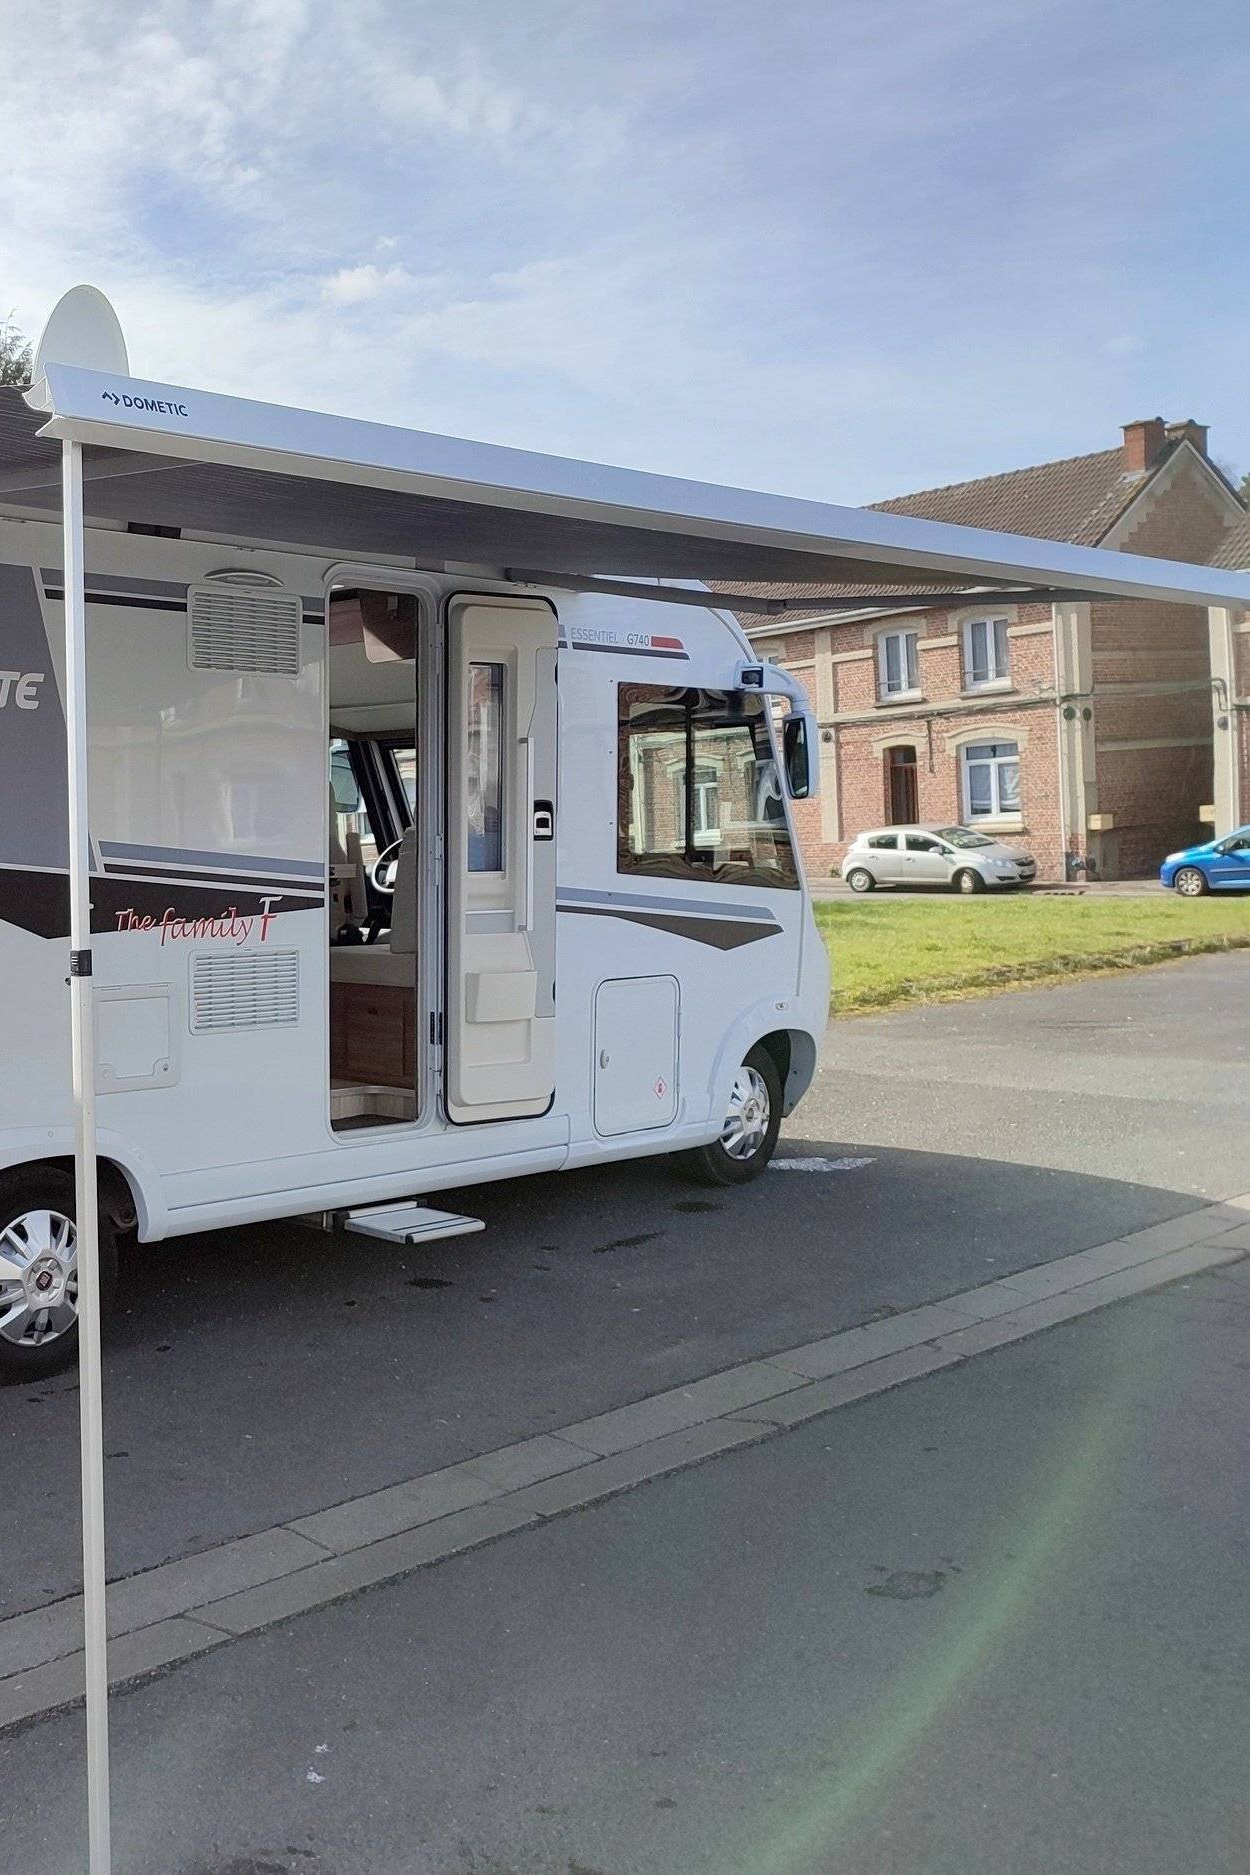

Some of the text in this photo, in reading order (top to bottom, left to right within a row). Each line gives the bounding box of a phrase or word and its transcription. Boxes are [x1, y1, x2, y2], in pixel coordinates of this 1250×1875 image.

[122, 395, 189, 417] DOMETIC
[571, 627, 650, 647] ESSENTIEL G740
[115, 908, 157, 932] The
[159, 907, 254, 946] family
